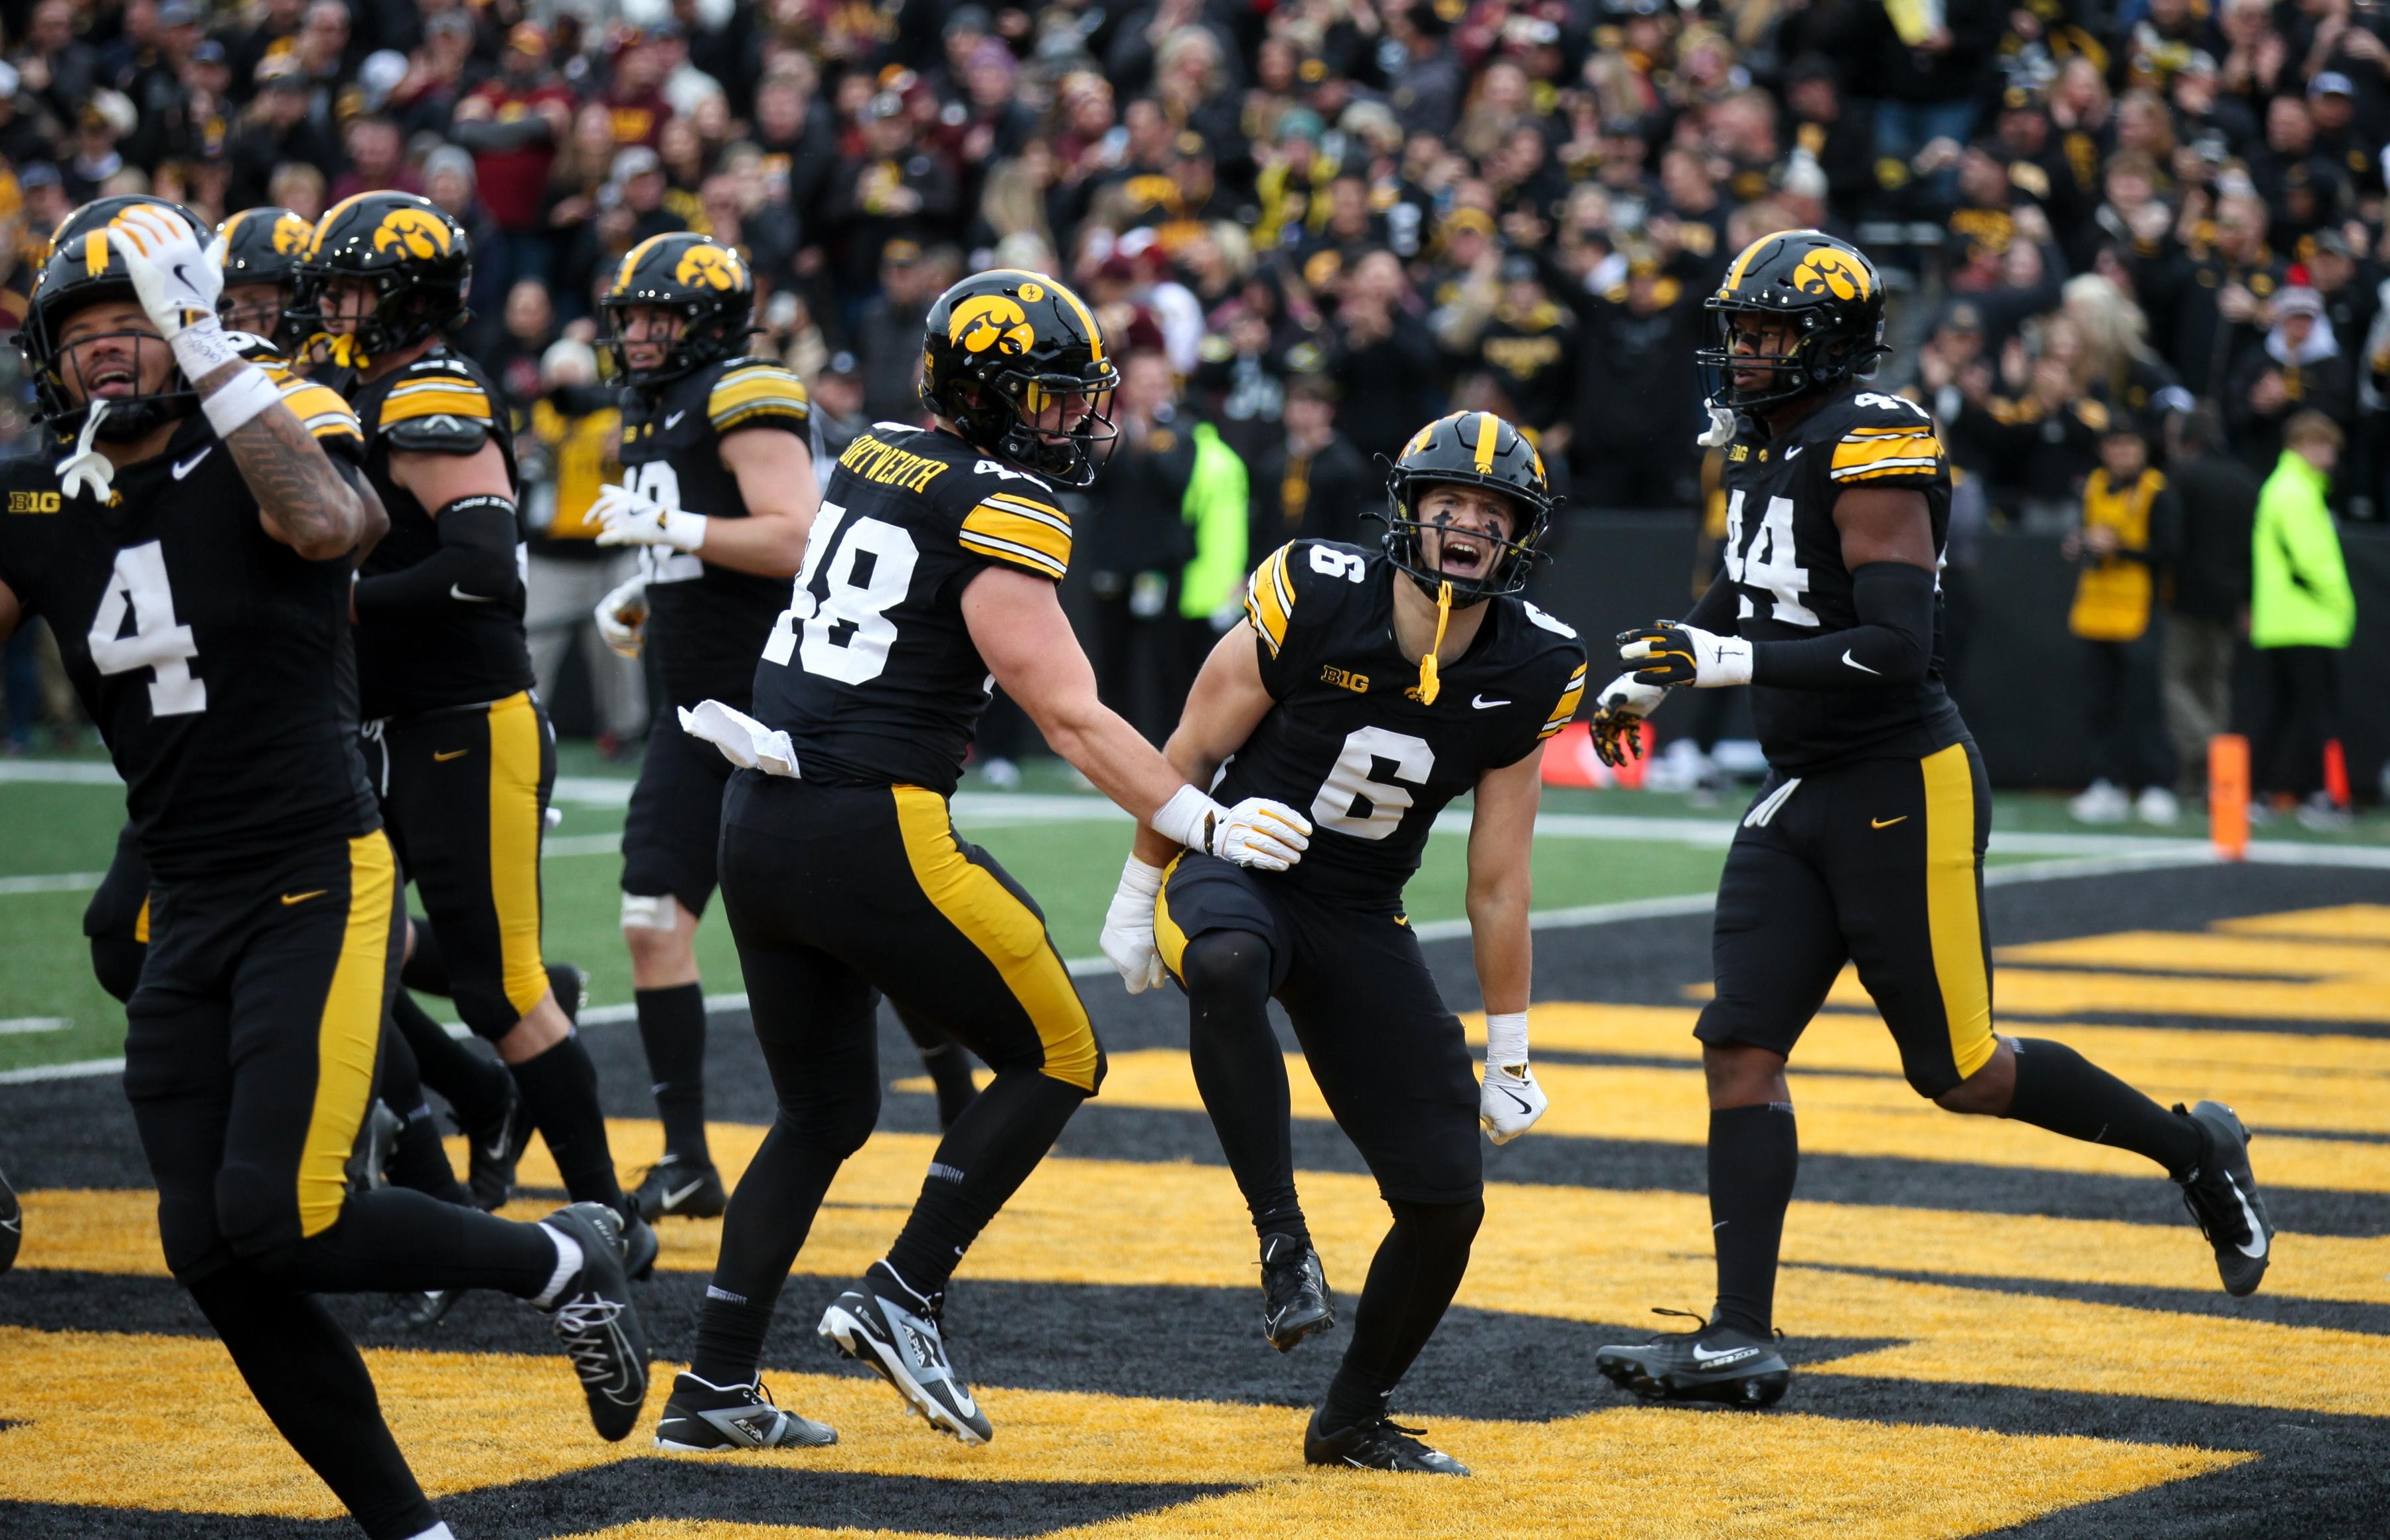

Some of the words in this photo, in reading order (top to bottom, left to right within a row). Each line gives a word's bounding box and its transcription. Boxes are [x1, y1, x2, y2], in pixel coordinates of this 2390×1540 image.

[88, 540, 206, 718] 4
[1310, 726, 1435, 840] 6
[902, 1324, 926, 1368] ALPHA
[734, 1419, 763, 1441] ALPHA
